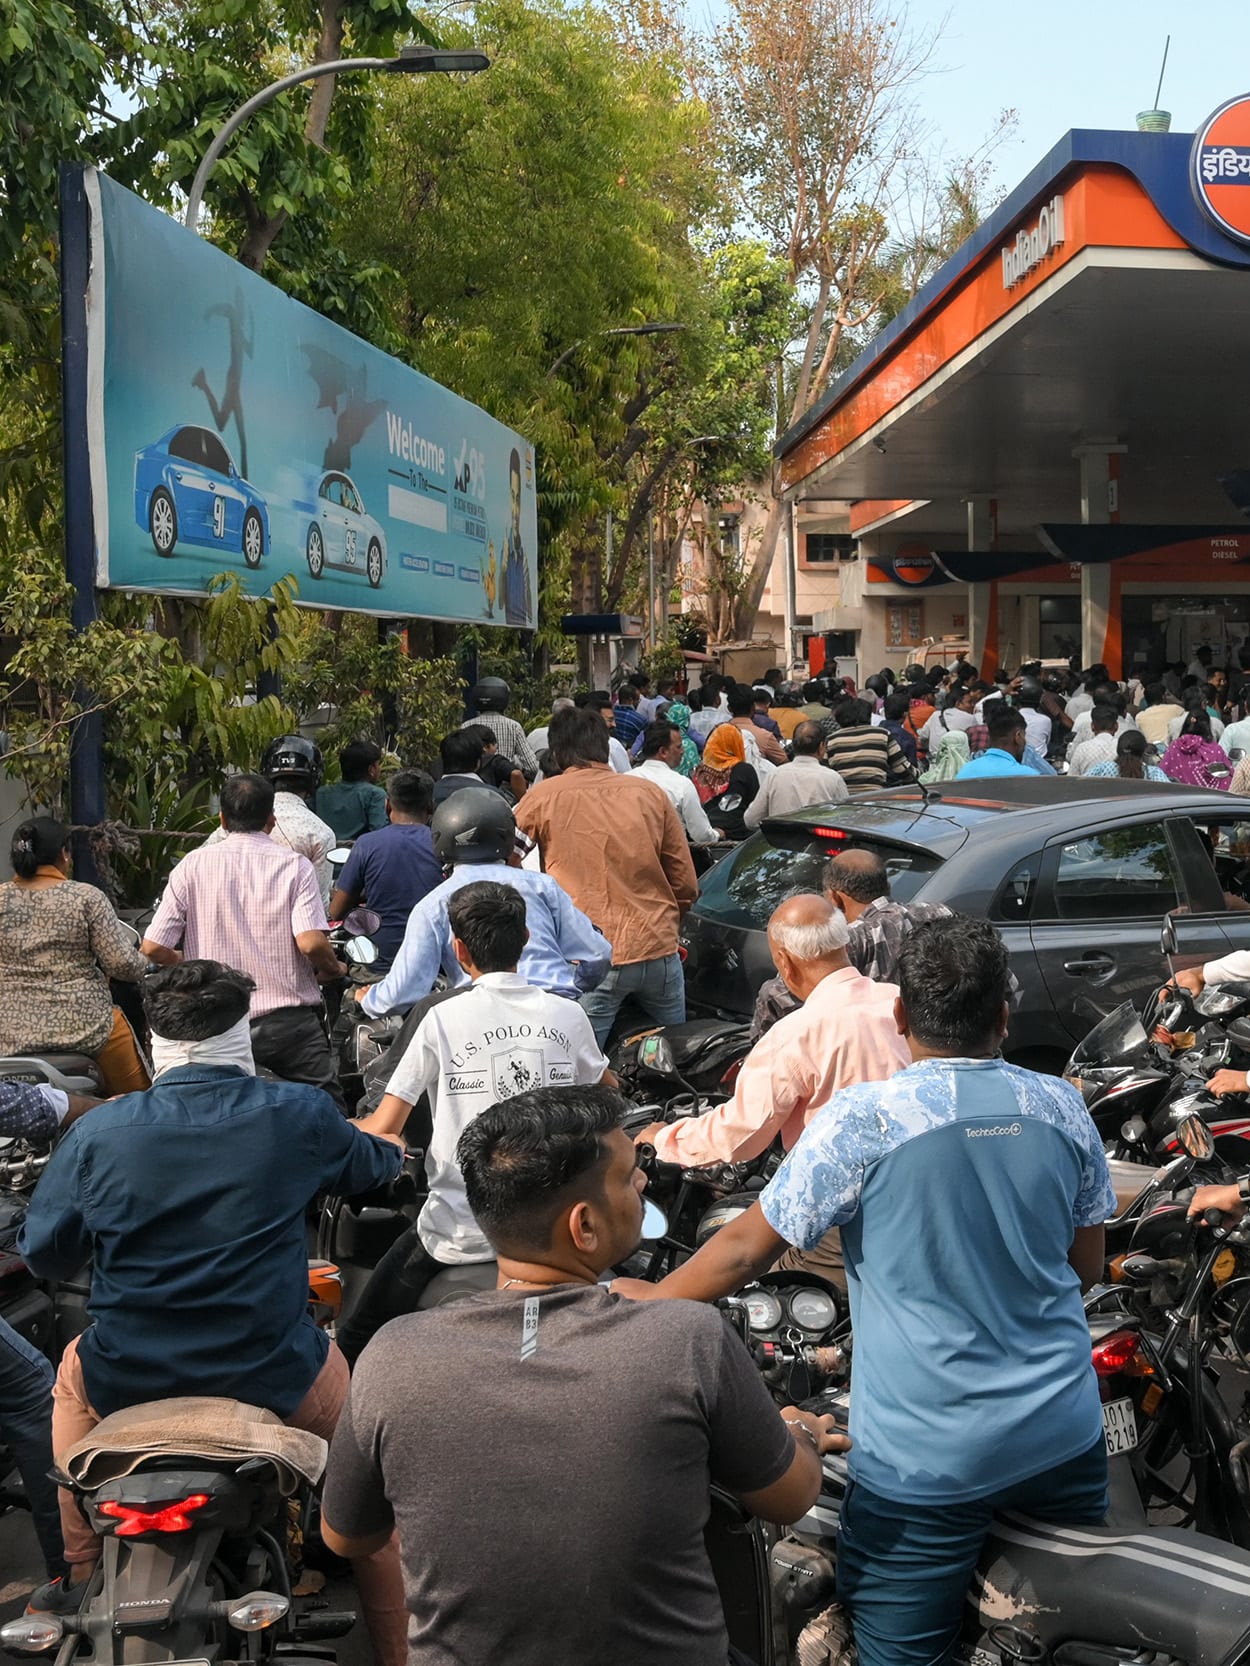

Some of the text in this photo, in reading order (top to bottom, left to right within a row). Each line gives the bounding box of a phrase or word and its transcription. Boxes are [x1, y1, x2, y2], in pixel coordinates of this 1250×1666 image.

[1001, 194, 1065, 290] IndianOil
[386, 411, 445, 476] Welcome
[409, 468, 429, 492] To The
[213, 496, 225, 539] 91
[344, 529, 357, 565] 95
[1210, 539, 1239, 547] PETROL
[1212, 551, 1238, 559] DIESEL
[450, 1041, 482, 1069] U.S.
[483, 1024, 531, 1046] POLO
[1, 1075, 38, 1083] ONDA
[449, 1077, 485, 1091] Classic
[1103, 1403, 1125, 1429] J01
[1106, 1424, 1136, 1453] 6219
[119, 1598, 171, 1608] HONDA
